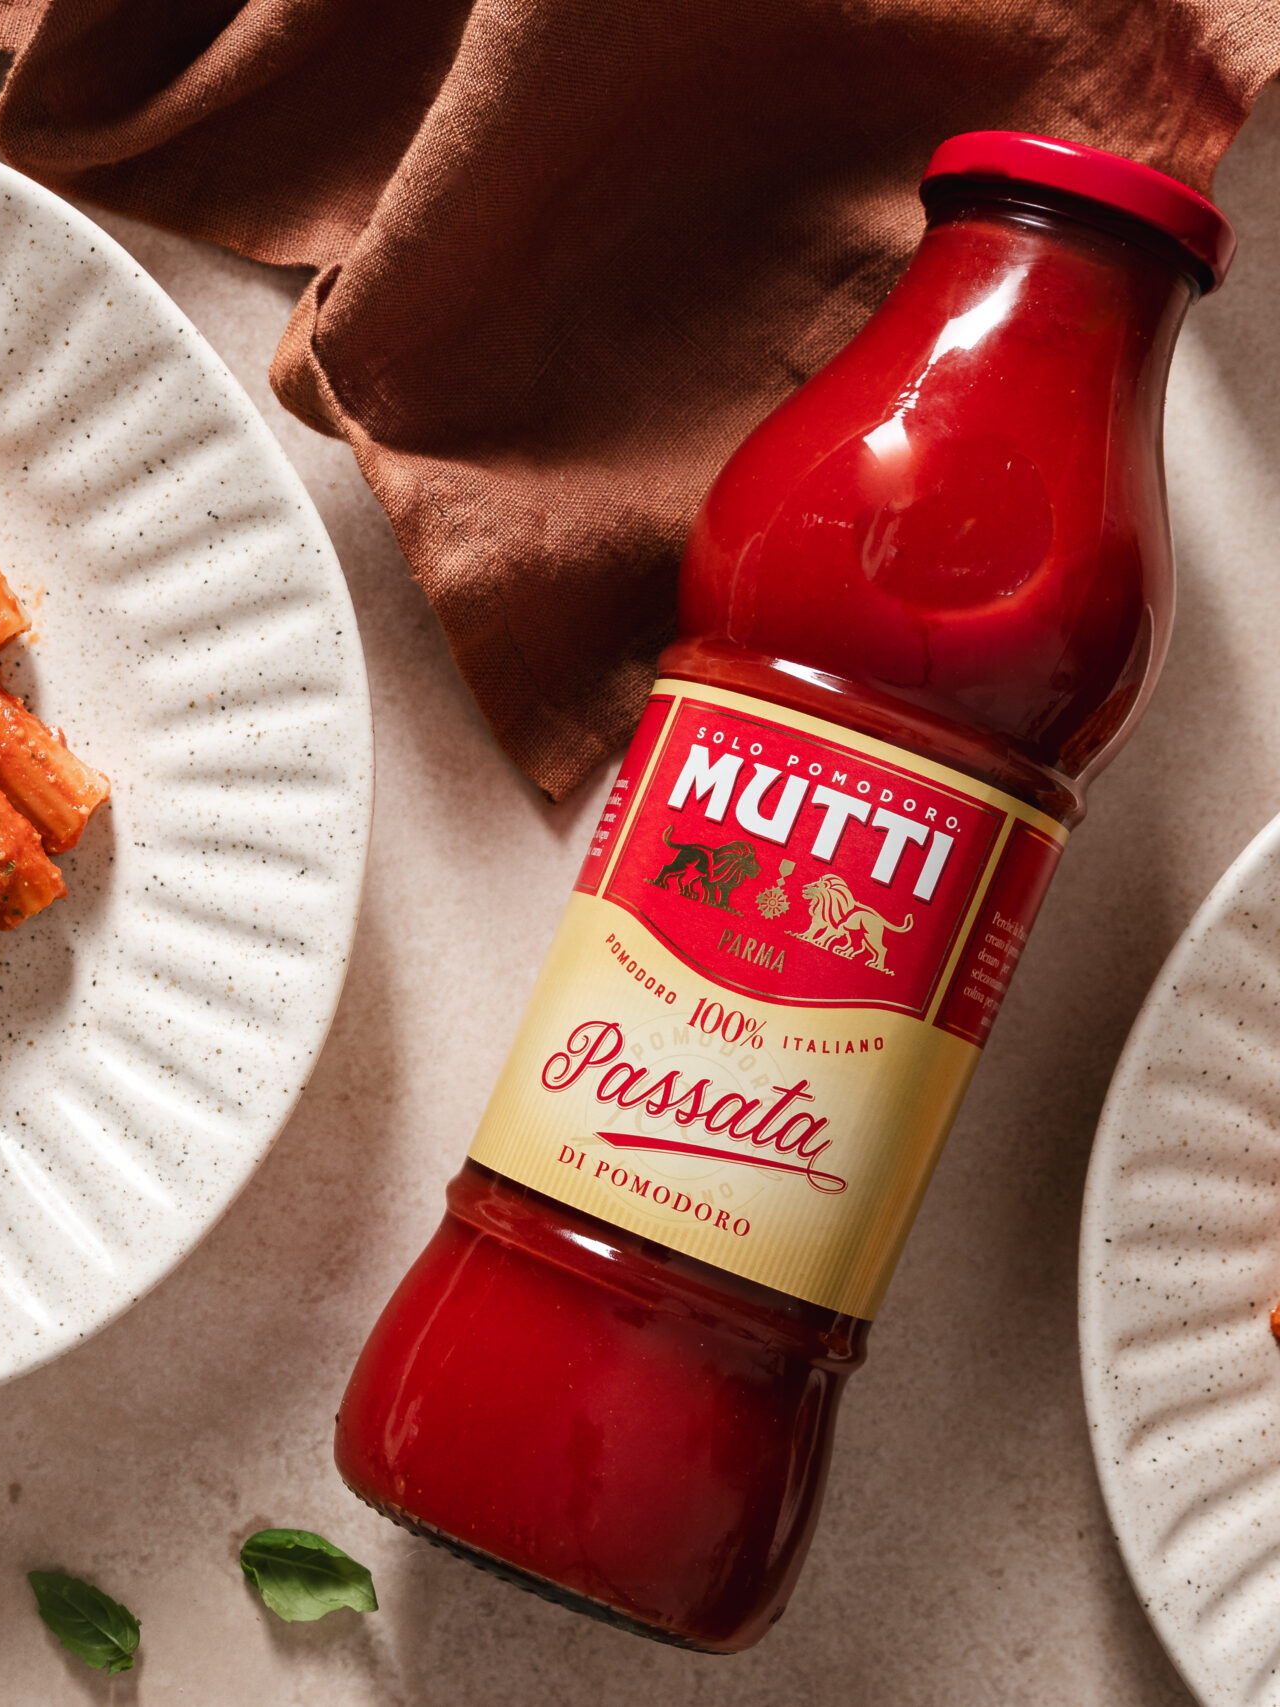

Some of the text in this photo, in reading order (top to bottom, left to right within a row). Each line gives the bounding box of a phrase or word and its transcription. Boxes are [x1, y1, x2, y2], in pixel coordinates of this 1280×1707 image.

[696, 726, 763, 756] SOLO
[667, 743, 956, 904] MUTTI
[605, 932, 885, 1054] POMODORO 100% ITALIANO
[718, 928, 786, 973] PARMA
[541, 1020, 848, 1194] Passata
[557, 1144, 587, 1171] DI
[593, 1160, 751, 1237] POMODORO
